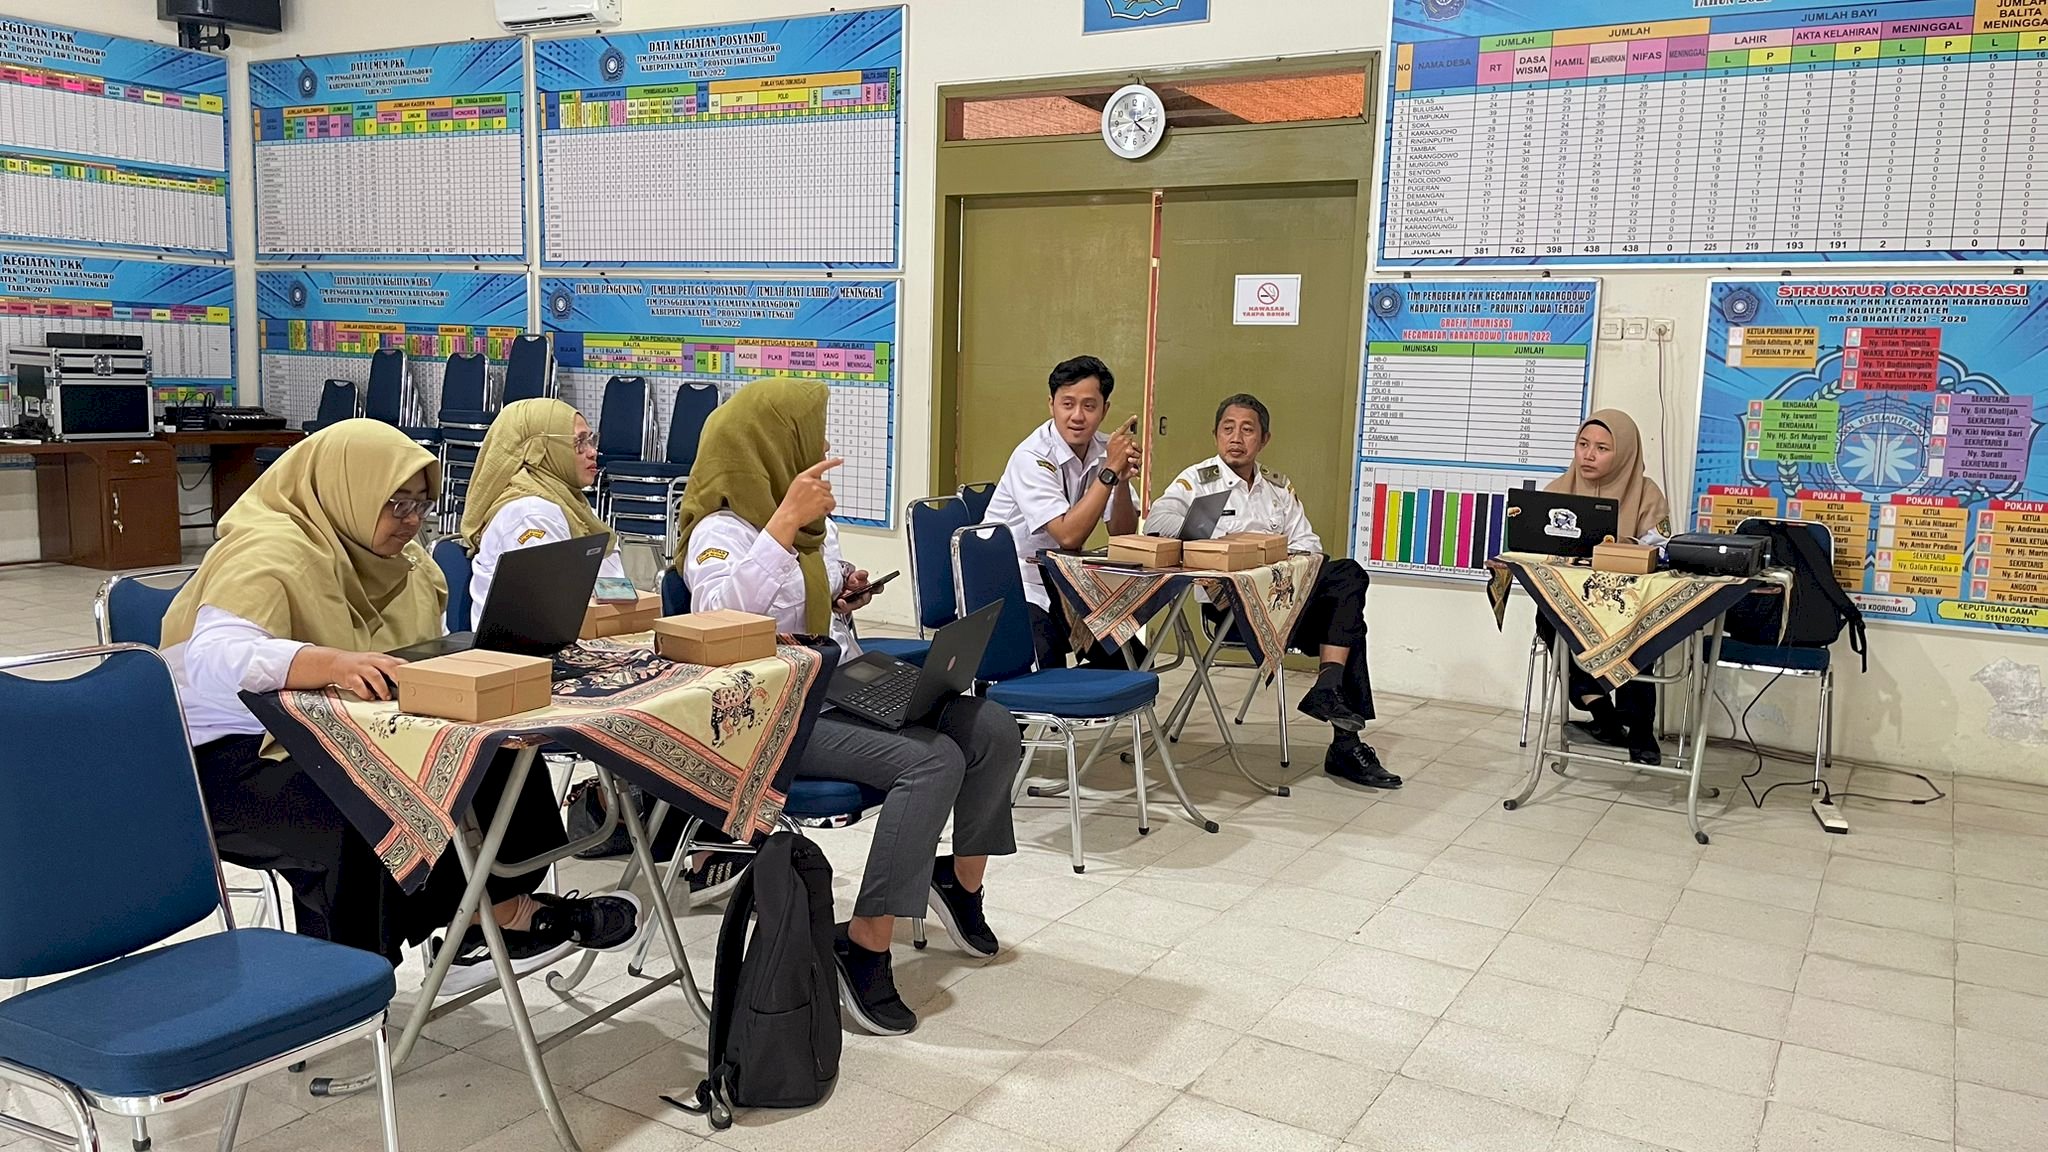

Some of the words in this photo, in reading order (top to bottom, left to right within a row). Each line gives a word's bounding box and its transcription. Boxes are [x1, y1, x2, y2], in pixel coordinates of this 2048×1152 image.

[1801, 12, 1847, 22] JUMLAH
[1852, 9, 1877, 18] BAYI
[2000, 8, 2041, 17] BALITA
[1609, 27, 1650, 37] JUMLAH
[1892, 22, 1963, 33] MENINGGAL
[51, 31, 74, 43] PKK
[1796, 32, 1820, 40] AKTA
[1824, 27, 1879, 38] KELAHIRAN
[649, 41, 670, 52] DATA
[674, 37, 716, 50] KEGIATAN
[720, 32, 767, 46] POSYANDU
[1496, 37, 1534, 47] JUMLAH
[1734, 35, 1767, 45] LAHIR
[1945, 41, 1952, 49] P
[1669, 48, 1706, 58] MENINGGAL
[1854, 46, 1861, 54] P
[1519, 56, 1546, 65] DASA
[1590, 54, 1626, 64] MELAHIRKAN
[1632, 51, 1662, 61] NIFAS
[1767, 52, 1774, 60] P
[1418, 61, 1444, 70] NAMA
[1446, 58, 1471, 67] DESA
[1555, 58, 1584, 67] HAMIL
[1490, 64, 1502, 72] RT
[1516, 66, 1548, 75] WISMA
[1474, 246, 1489, 254] 381
[1510, 246, 1526, 254] 762
[1584, 245, 1600, 253] 438
[1622, 244, 1638, 252] 438
[1703, 242, 1717, 251] 225
[1745, 242, 1759, 250] 219
[1786, 241, 1804, 250] 193
[1829, 240, 1847, 249] 191
[4, 256, 56, 268] KEGIATAN
[60, 260, 82, 269] PKK
[576, 284, 599, 294] JUMLAH
[602, 285, 642, 294] PENGUNJUNG
[651, 285, 676, 295] JUMLAH
[679, 285, 708, 296] PETUGAS
[711, 286, 746, 296] POSYANDU
[756, 286, 784, 297] JUMLAH
[786, 287, 805, 297] BAYI
[807, 287, 829, 297] LAHIR
[840, 288, 883, 298] MENINGGAL
[1778, 285, 1886, 297] STRUKTUR
[1890, 284, 2028, 297] ORGANISASI
[1407, 291, 1420, 300] TIM
[1423, 292, 1466, 300] PENGGERAK
[1469, 292, 1483, 300] PKK
[1486, 292, 1532, 301] KECAMATAN
[1535, 292, 1591, 301] KARANGDOWO
[1410, 304, 1451, 312] KABUPATEN
[1454, 304, 1480, 312] KLATEN
[1491, 304, 1527, 313] PROVINSI
[1529, 304, 1551, 313] JAWA
[1555, 304, 1585, 313] TENGAH
[1440, 318, 1467, 328] GRAFIK
[1470, 318, 1512, 328] IMUNISASI
[1403, 330, 1447, 340] KECAMATAN
[1450, 330, 1502, 340] KARANGDOWO
[1504, 331, 1528, 341] TAHUN
[1531, 331, 1551, 341] 2022
[1813, 492, 1838, 500] POKJA
[1906, 497, 1932, 505] POKJA
[2005, 502, 2032, 511] POKJA
[1958, 603, 2008, 614] KEPUTUSAN
[2010, 607, 2039, 616] CAMAT
[1985, 614, 2030, 624] 511/10/2021
